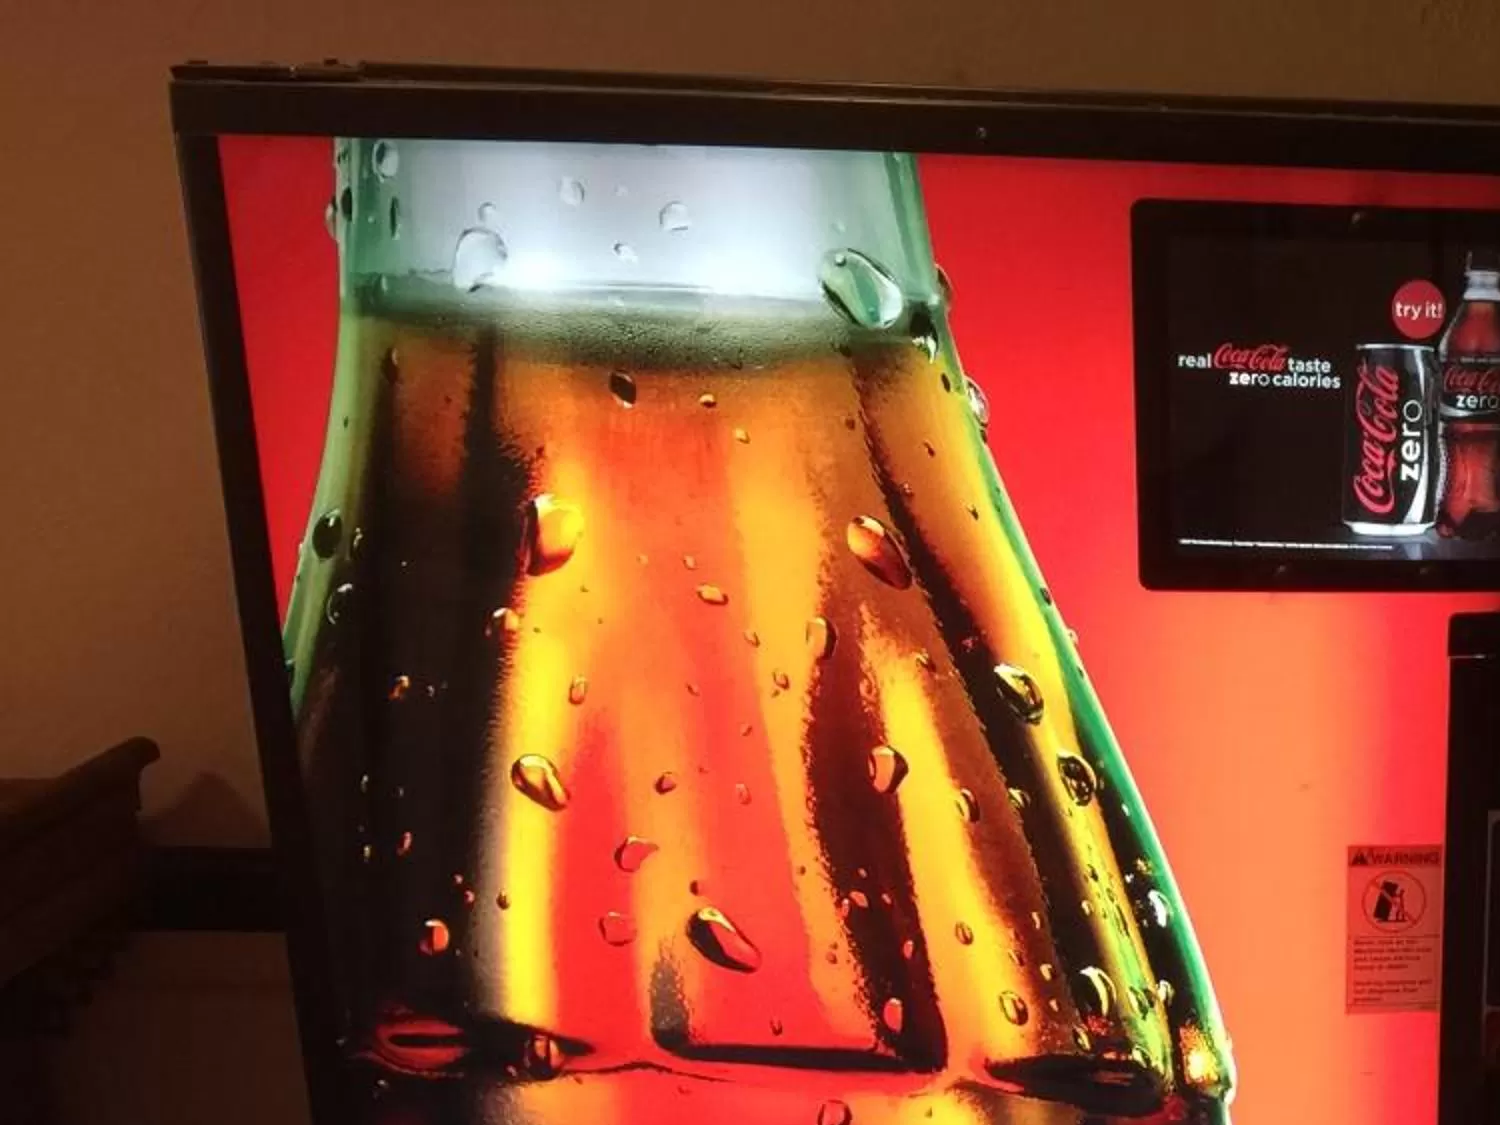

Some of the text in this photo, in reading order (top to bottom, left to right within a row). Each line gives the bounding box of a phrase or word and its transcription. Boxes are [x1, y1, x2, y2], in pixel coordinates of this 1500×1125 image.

[1395, 300, 1443, 321] try it!
[1177, 353, 1212, 369] real
[1287, 357, 1331, 373] taste
[1228, 371, 1342, 389] zero calories
[1455, 394, 1500, 409] zero
[1400, 399, 1423, 482] zero
